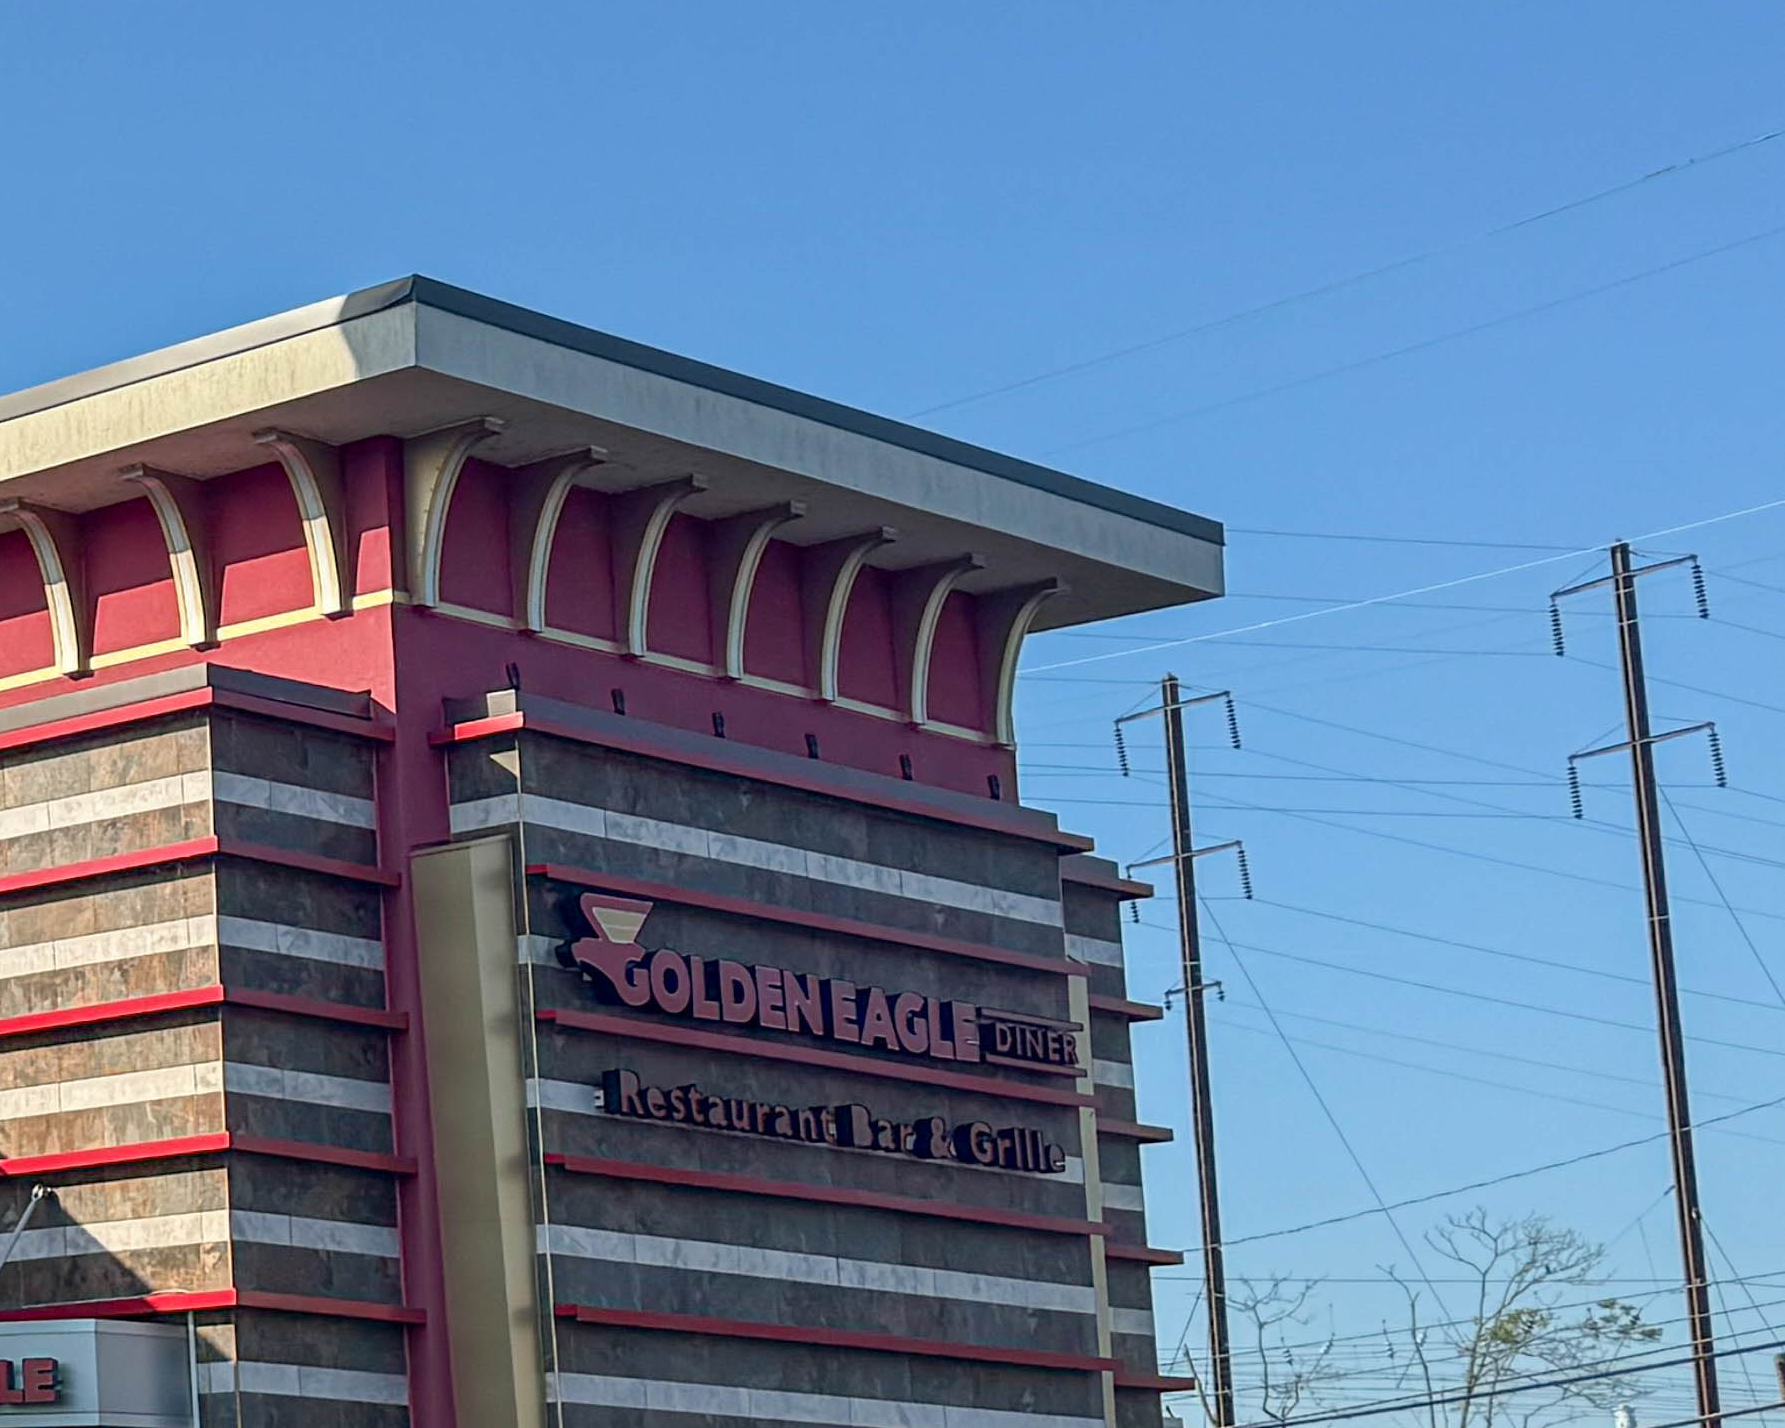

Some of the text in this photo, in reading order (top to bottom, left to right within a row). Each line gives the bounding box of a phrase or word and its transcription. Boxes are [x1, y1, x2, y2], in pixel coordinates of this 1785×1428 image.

[617, 948, 1080, 1065] GOLDEN EAGLE DINER
[607, 1068, 835, 1143] Restaurant
[839, 1104, 915, 1152] Bar
[957, 1121, 1066, 1173] Grille
